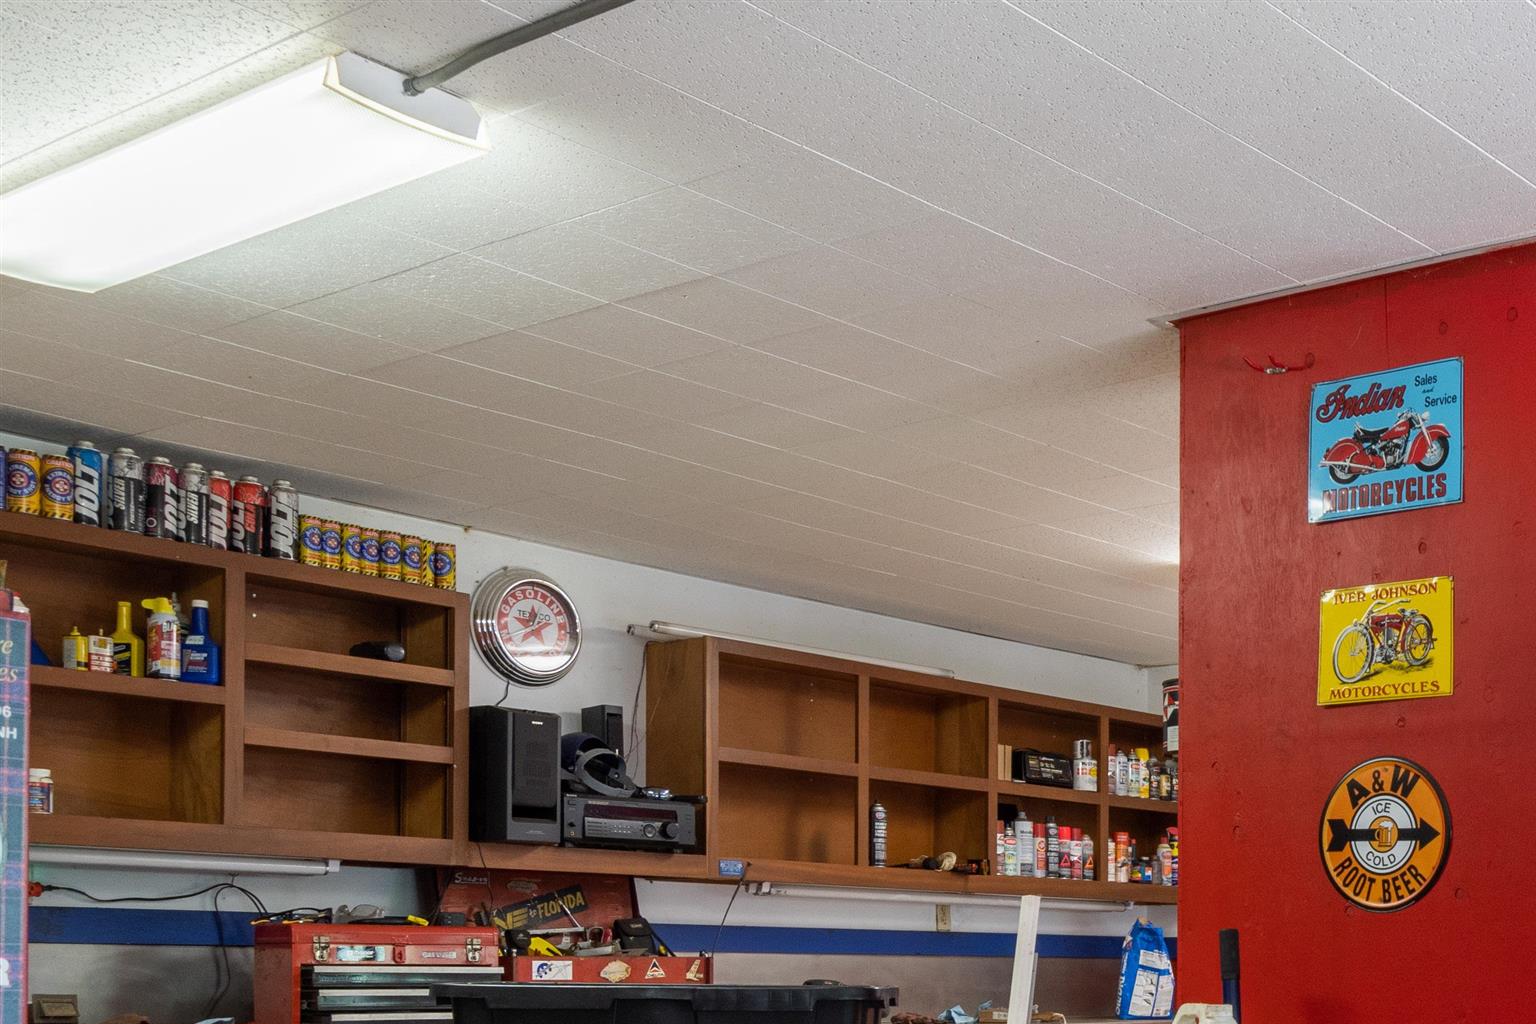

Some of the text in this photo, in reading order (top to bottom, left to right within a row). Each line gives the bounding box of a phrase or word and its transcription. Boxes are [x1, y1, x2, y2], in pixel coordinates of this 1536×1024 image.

[1414, 373, 1438, 387] Sales
[1316, 382, 1407, 424] Indian
[1424, 393, 1458, 408] Service
[75, 457, 99, 527] JOLT
[114, 478, 126, 510] SILVER
[1322, 472, 1447, 514] MOTORCYCLES
[272, 494, 294, 560] JOLT
[501, 589, 566, 624] GASOLINE
[1333, 590, 1366, 605] IVER
[1371, 582, 1438, 601] JOHNSON
[1329, 680, 1440, 700] MOTORCYCLES
[1371, 802, 1391, 815] ICE
[1365, 851, 1397, 867] COLD
[1333, 857, 1376, 902] ROOT
[1382, 864, 1427, 904] BEER
